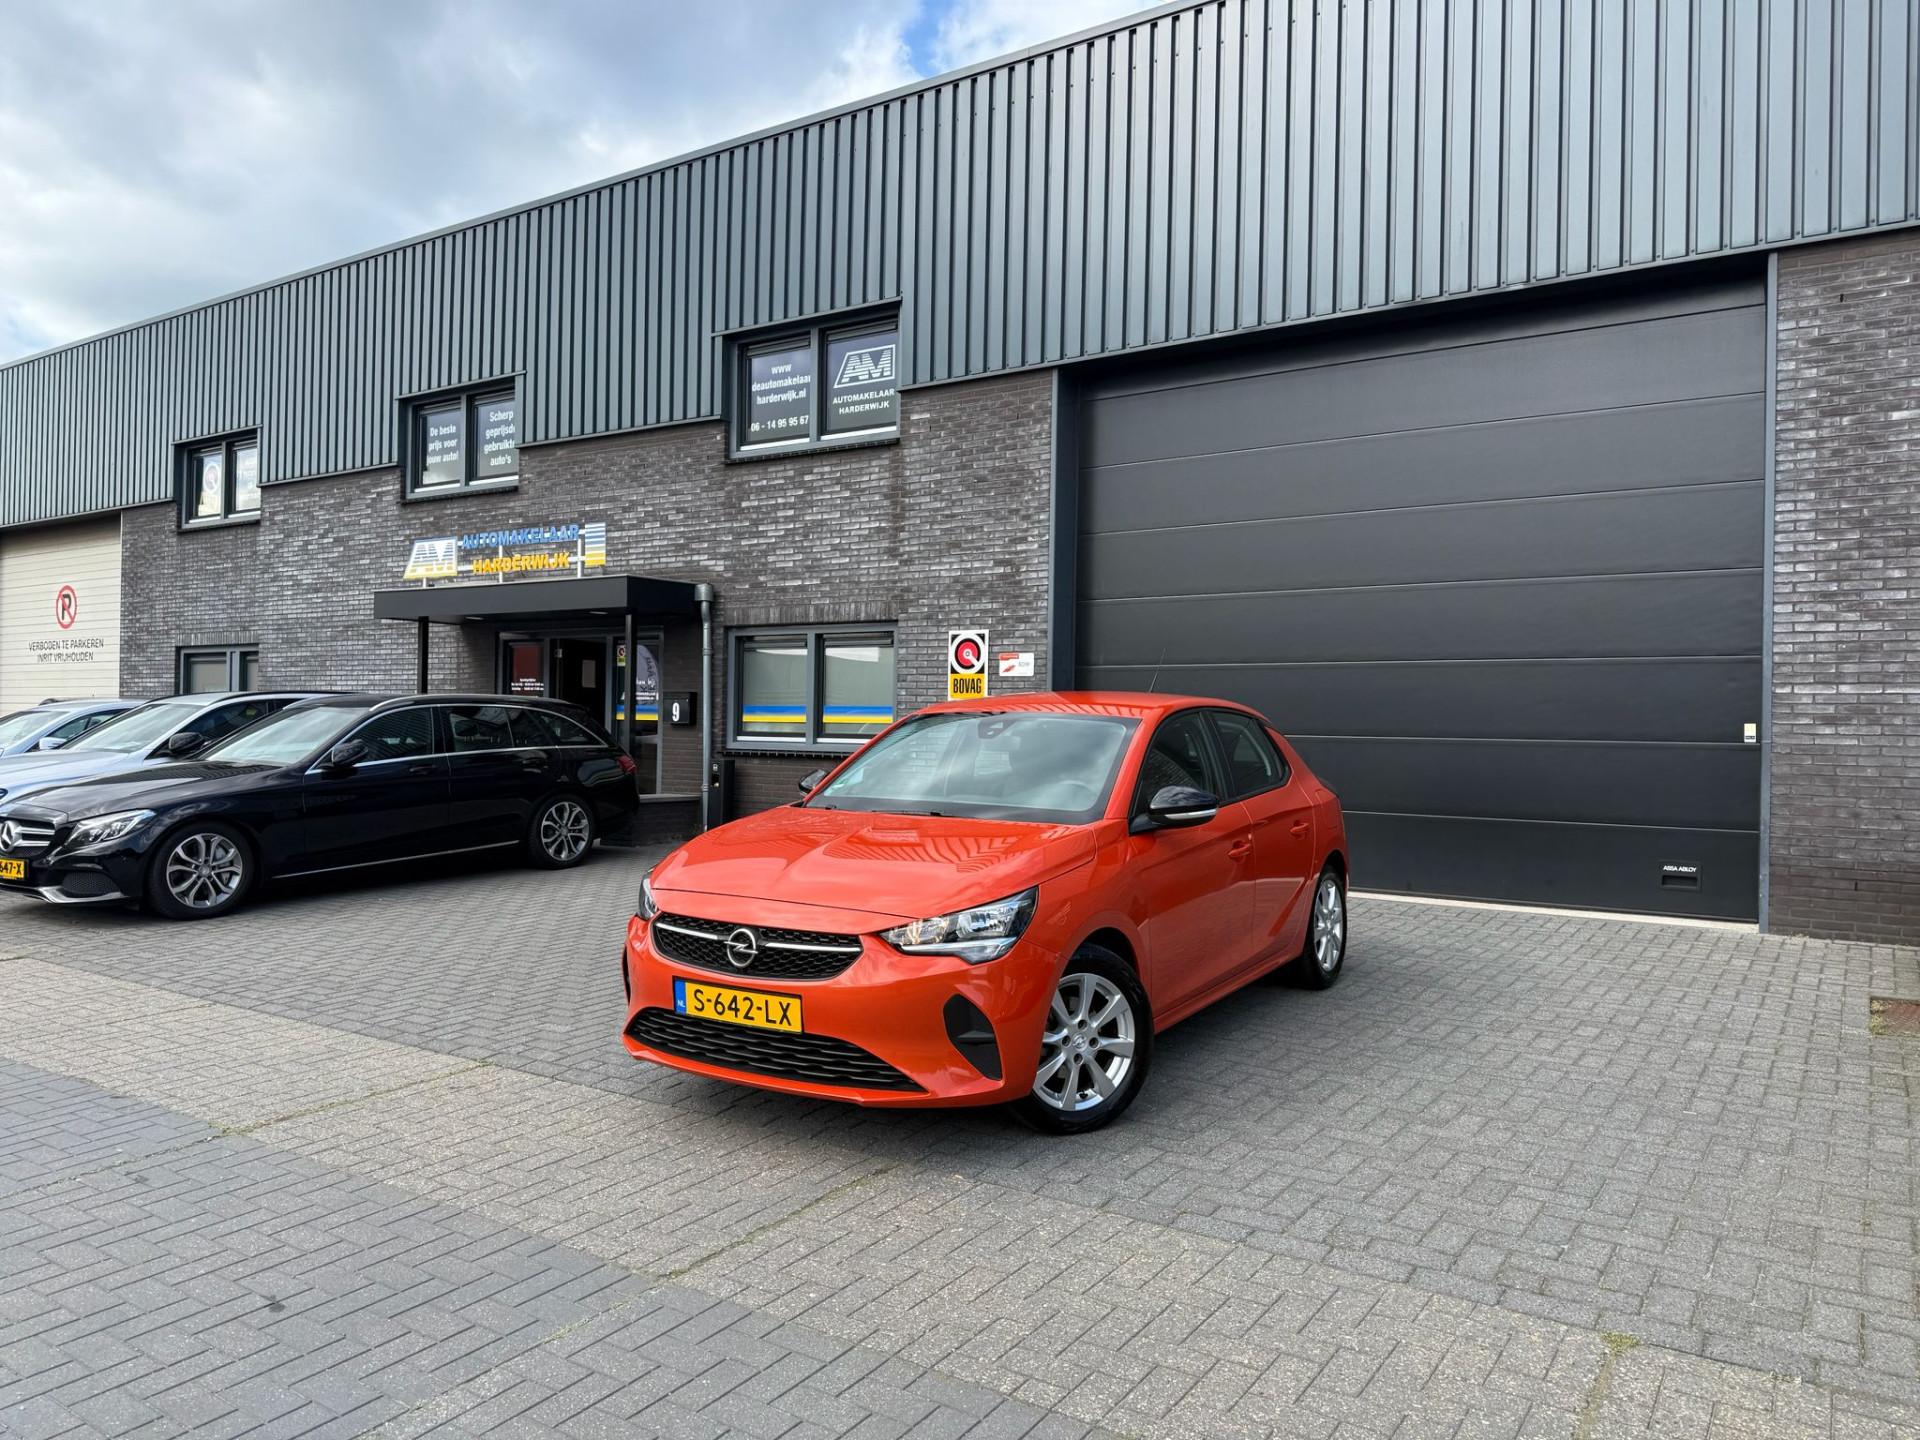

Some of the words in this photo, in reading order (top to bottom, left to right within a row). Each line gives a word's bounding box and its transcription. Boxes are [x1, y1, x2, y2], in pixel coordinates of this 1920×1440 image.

[771, 364, 792, 375] www
[756, 387, 806, 405] harderwijk.nl
[832, 388, 895, 405] AUTOMAKELAAR
[838, 400, 890, 415] HARDERWIJK
[489, 410, 514, 422] Scherp
[429, 427, 438, 437] De
[439, 423, 456, 435] beste
[750, 422, 760, 432] 06
[767, 420, 776, 430] 14
[788, 416, 798, 427] 95
[428, 440, 442, 453] prijs
[443, 438, 458, 449] voor
[426, 454, 441, 466] jouw
[490, 454, 512, 466] auto's
[461, 524, 579, 549] AUTOMAKELAAR
[472, 550, 570, 576] HARDERWIJK
[28, 640, 60, 652] VERBODEN
[61, 639, 69, 650] TE
[70, 638, 104, 649] PARKEREN
[37, 652, 53, 663] INRIT
[953, 678, 982, 694] BOVAG
[671, 702, 681, 722] 9
[693, 988, 792, 1027] S-642-LX
